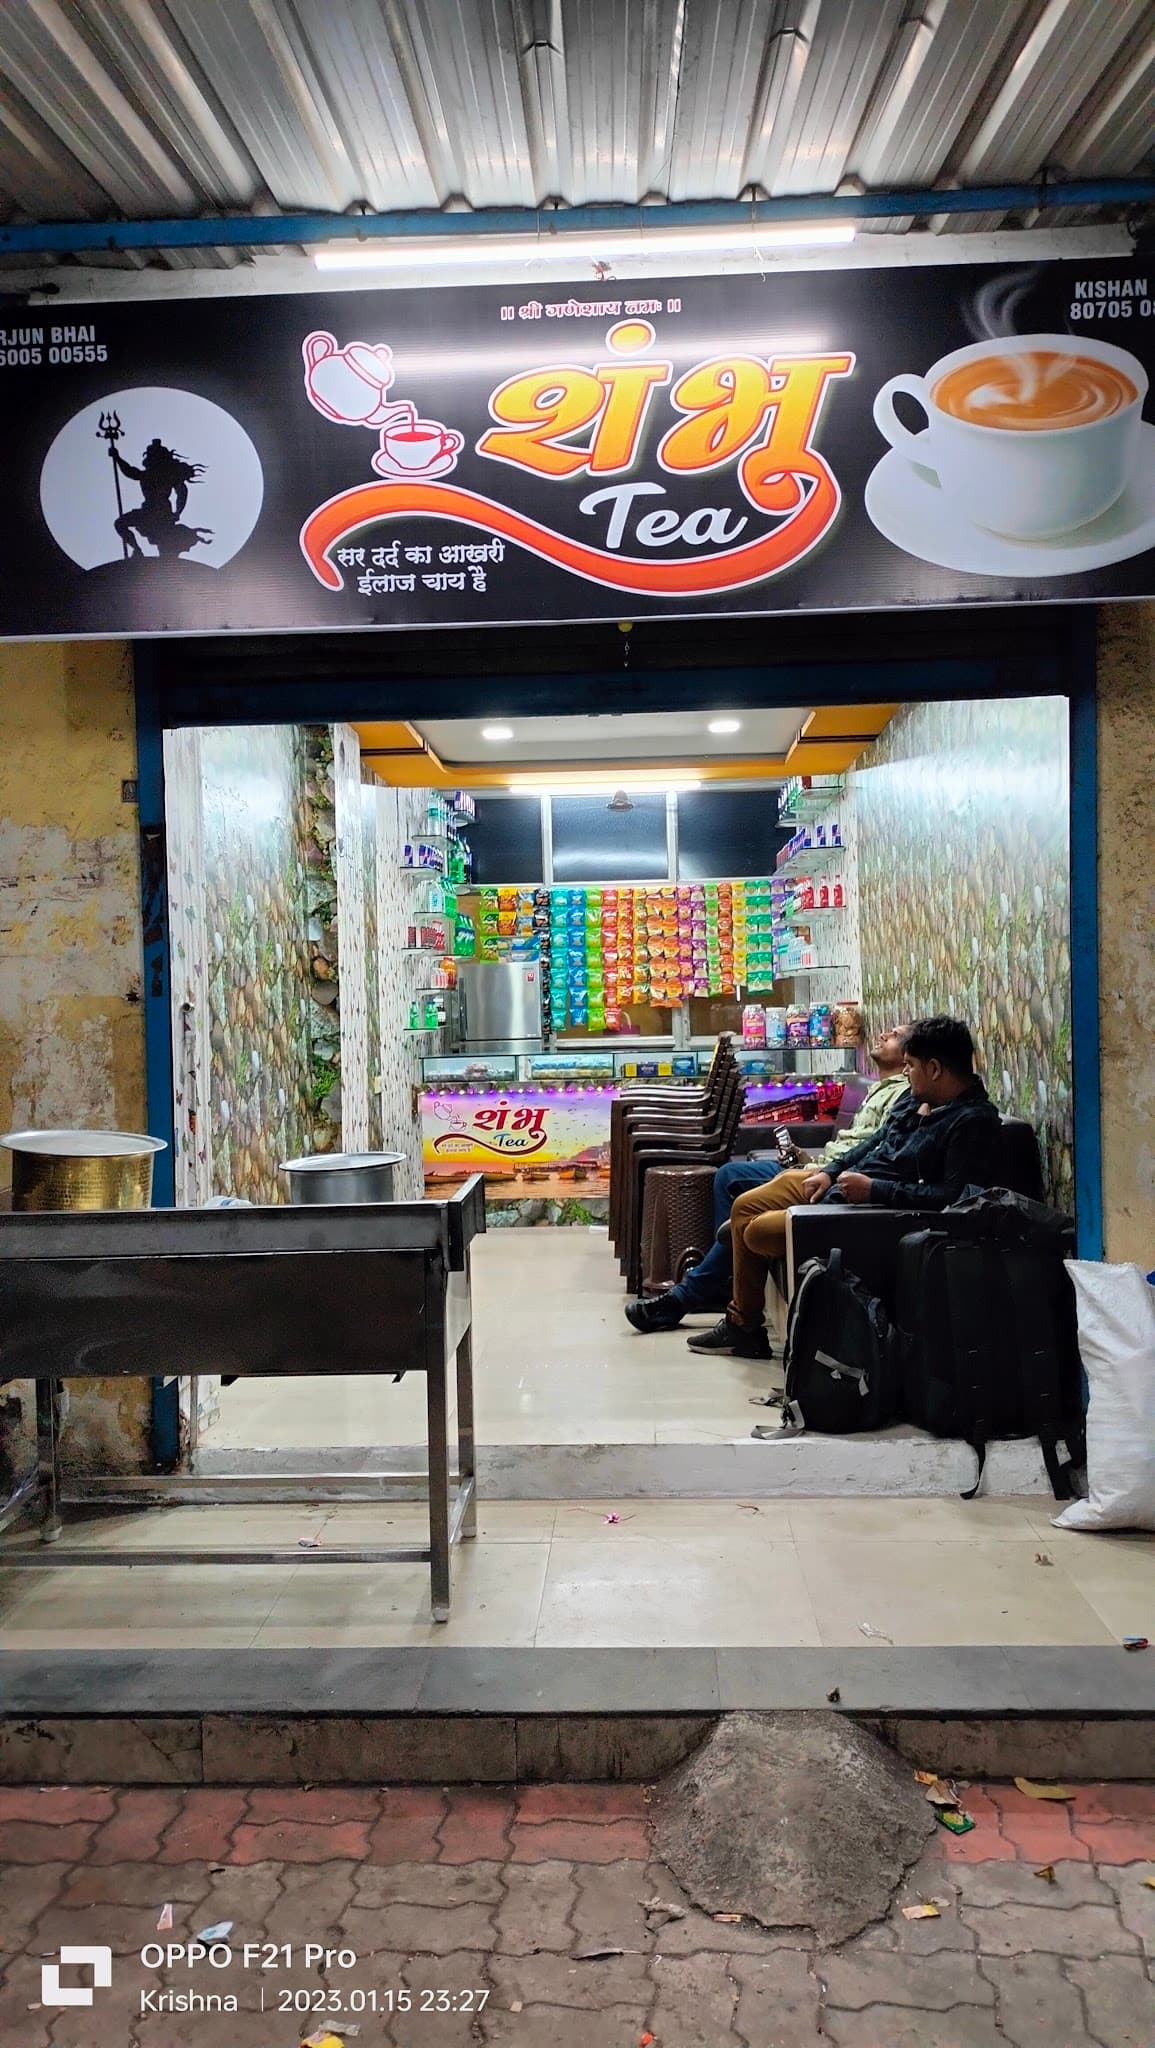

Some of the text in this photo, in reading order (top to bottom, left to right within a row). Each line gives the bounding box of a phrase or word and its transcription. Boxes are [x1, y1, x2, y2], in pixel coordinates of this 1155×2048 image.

[1075, 279, 1148, 299] KISHAN
[518, 301, 543, 320] श्री
[545, 299, 622, 318] गणेशाय
[625, 300, 662, 314] नमः
[1070, 299, 1155, 320] 80705 0
[51, 325, 96, 344] BHAI
[48, 345, 108, 364] 00555
[475, 318, 857, 516] शंभु
[579, 482, 748, 549] Tea
[337, 537, 505, 568] सर दर्द का आखरी
[357, 565, 487, 596] ईलाज चाय है
[472, 1100, 550, 1139] शंभु
[493, 1133, 528, 1148] Tea
